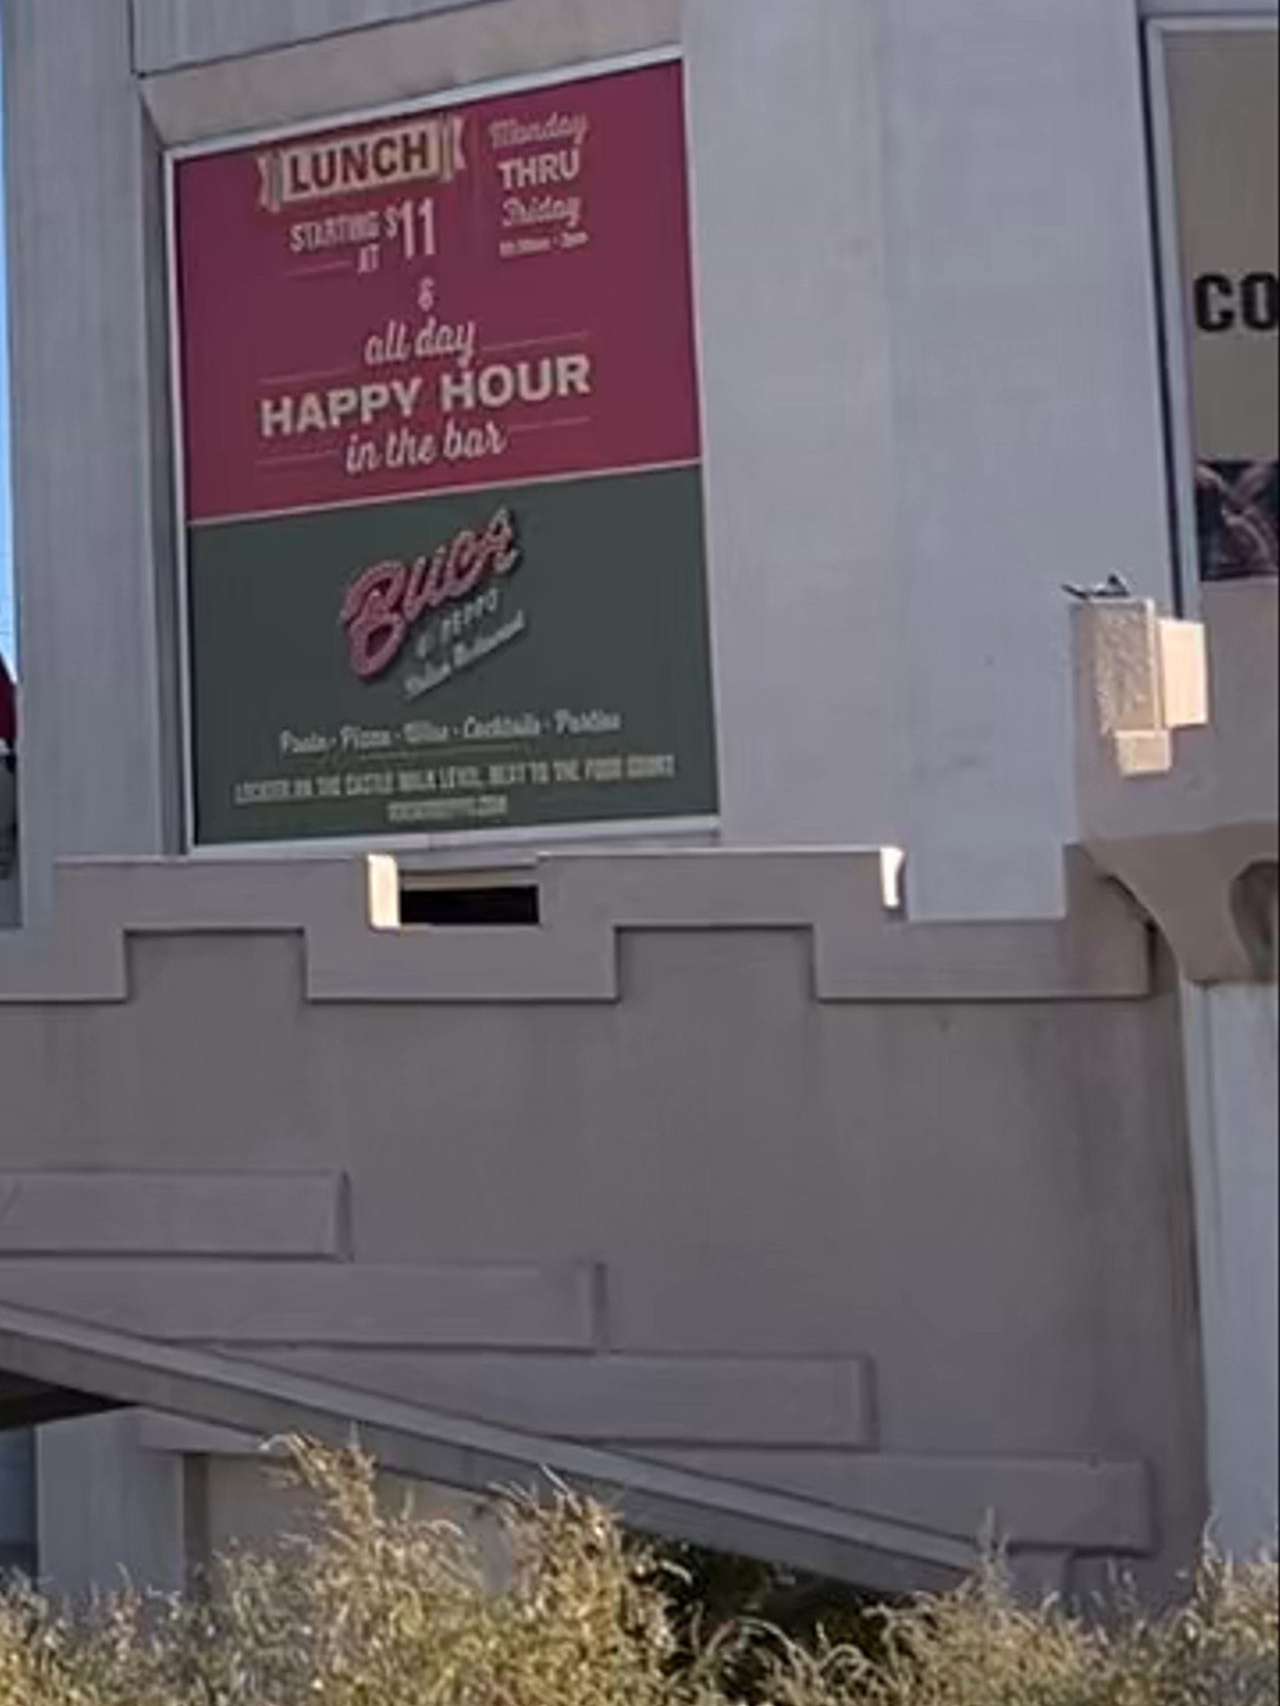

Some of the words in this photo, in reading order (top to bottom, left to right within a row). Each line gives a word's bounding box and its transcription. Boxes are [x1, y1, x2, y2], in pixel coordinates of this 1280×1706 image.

[490, 111, 588, 148] Monday
[291, 131, 429, 191] LUNCH
[497, 149, 581, 189] THRU
[290, 210, 380, 254] STARTING
[383, 197, 436, 260] $11
[502, 195, 581, 227] Friday
[357, 244, 380, 274] AT
[364, 320, 414, 365] all
[414, 316, 476, 367] day
[260, 375, 423, 439] HAPPY
[441, 353, 592, 412] HOUR
[344, 433, 384, 474] in
[385, 427, 438, 468] the
[442, 417, 508, 460] bar
